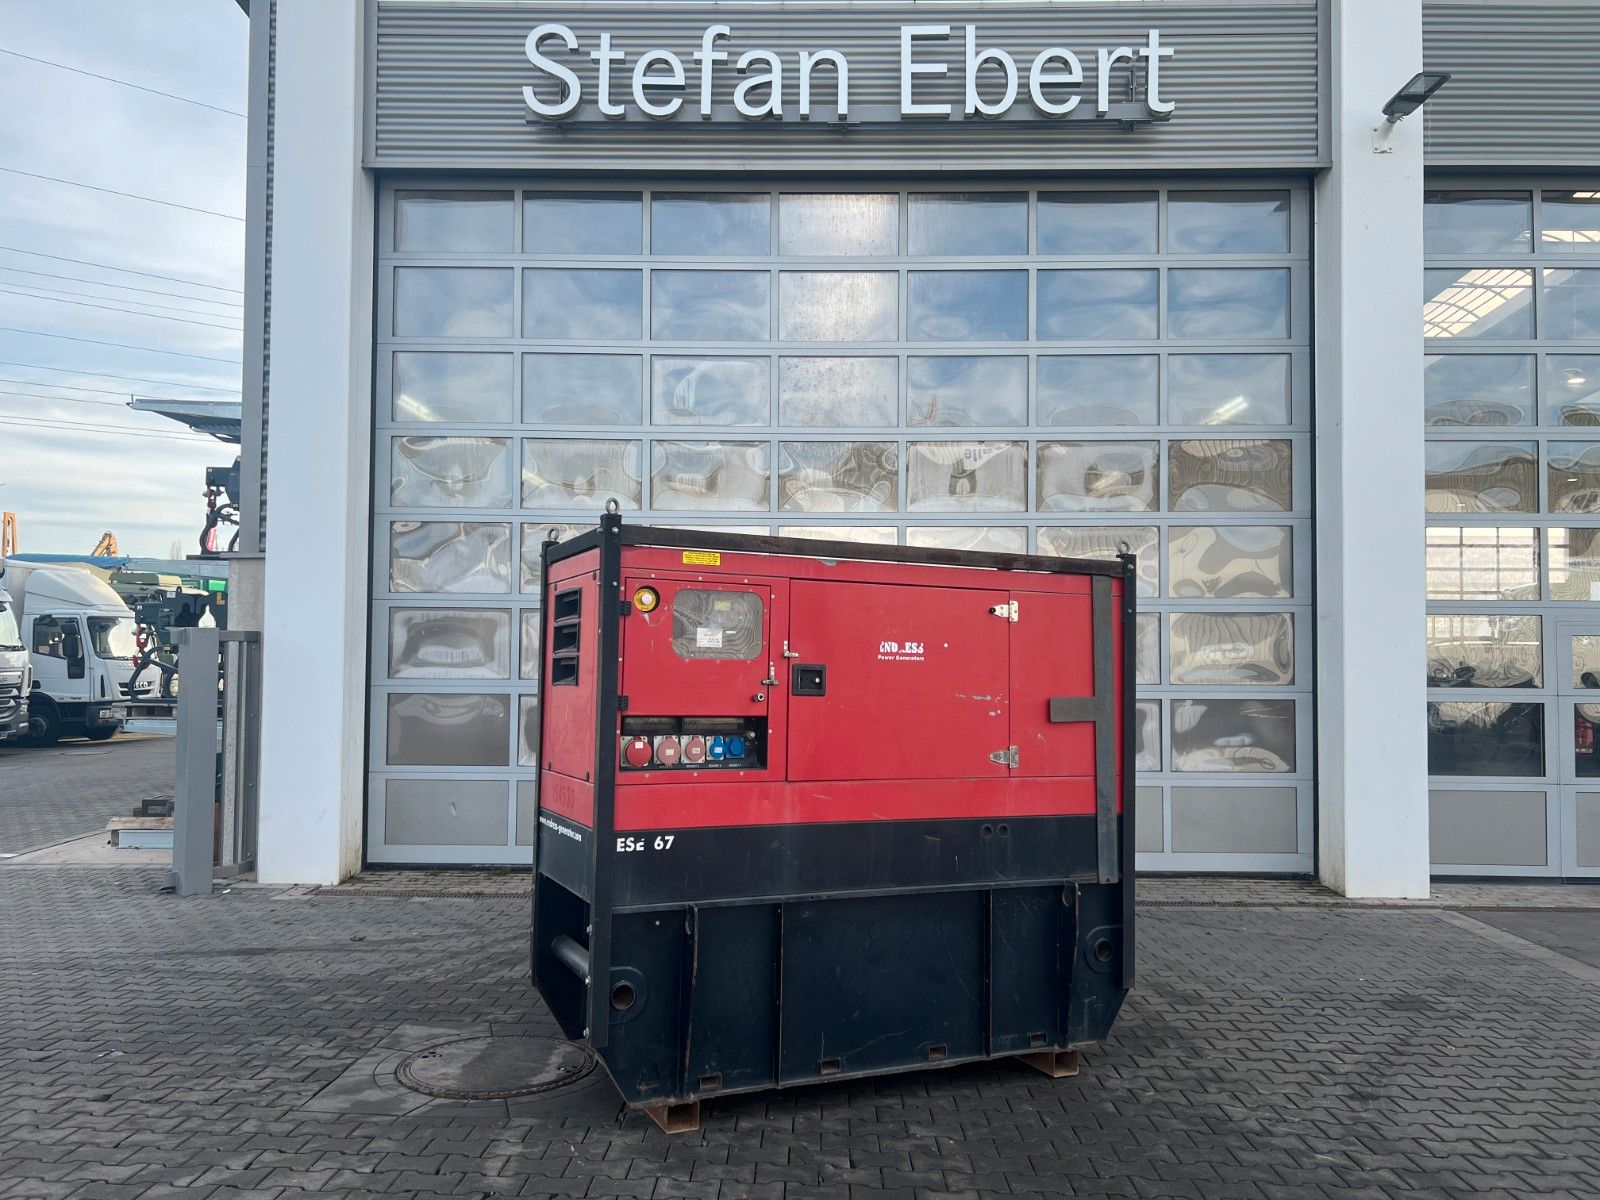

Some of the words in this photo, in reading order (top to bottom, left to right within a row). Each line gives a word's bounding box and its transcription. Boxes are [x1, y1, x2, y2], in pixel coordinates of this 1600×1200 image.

[522, 23, 849, 119] Stefan
[900, 25, 1176, 118] Ebert
[616, 837, 646, 852] ESE
[654, 835, 675, 850] 67
